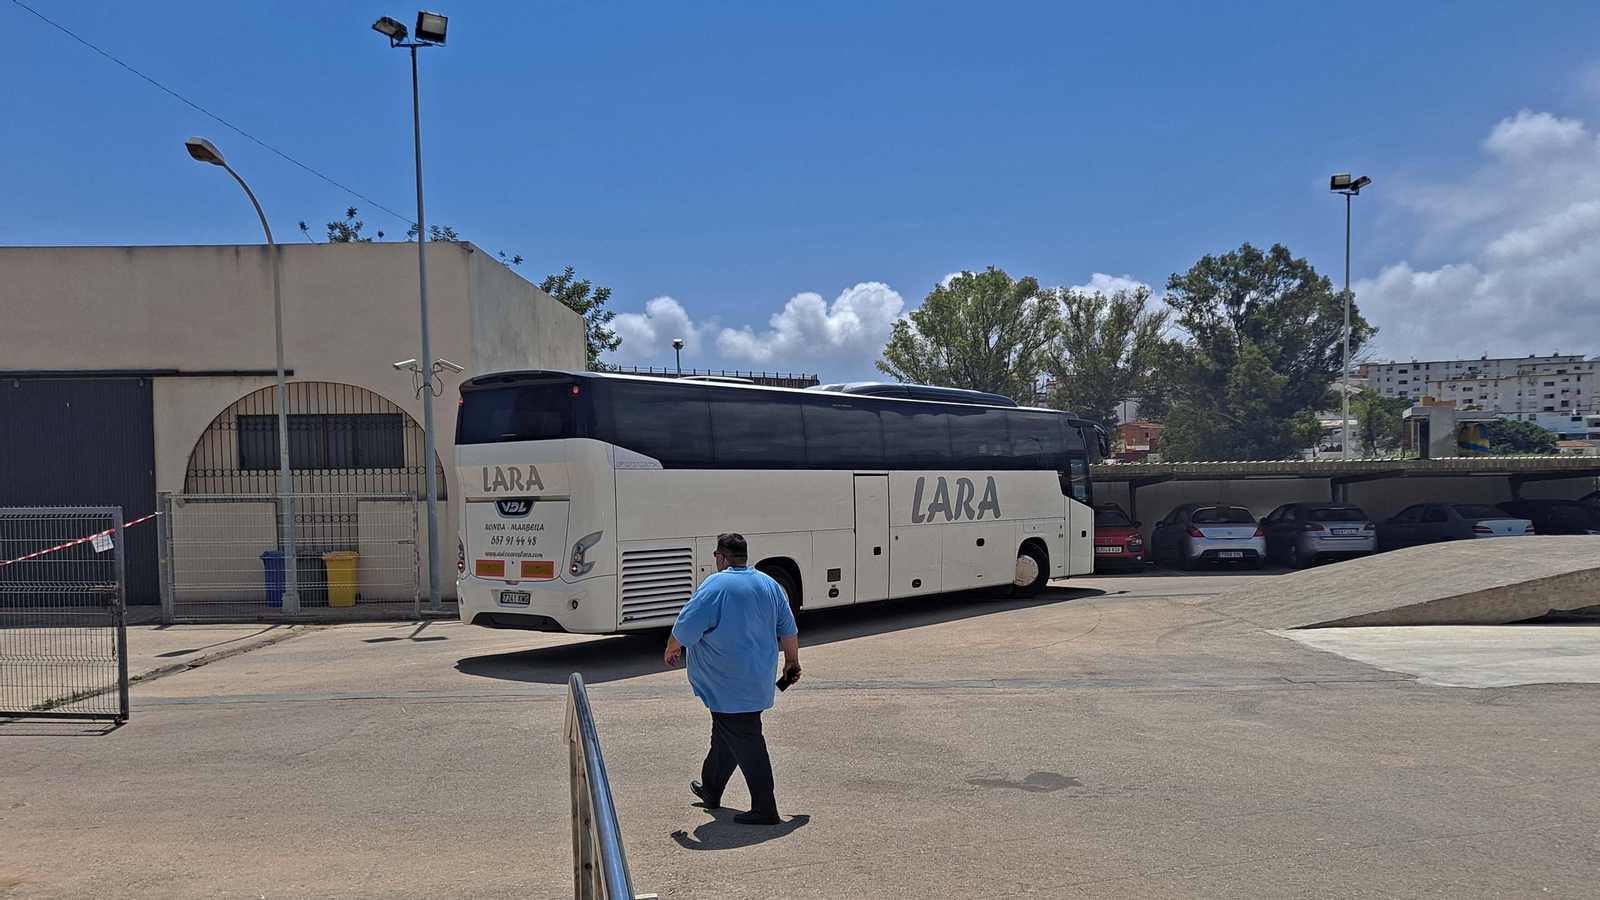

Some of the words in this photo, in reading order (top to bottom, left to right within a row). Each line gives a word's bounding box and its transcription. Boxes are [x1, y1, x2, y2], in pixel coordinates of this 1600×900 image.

[482, 465, 545, 492] LARA
[911, 476, 1002, 524] LARA
[501, 501, 527, 513] VDL
[484, 523, 506, 531] RONDA
[510, 523, 545, 532] MARBELLA
[505, 536, 514, 546] 91
[515, 536, 526, 546] 44
[527, 536, 538, 546] 48
[503, 594, 517, 602] 7241
